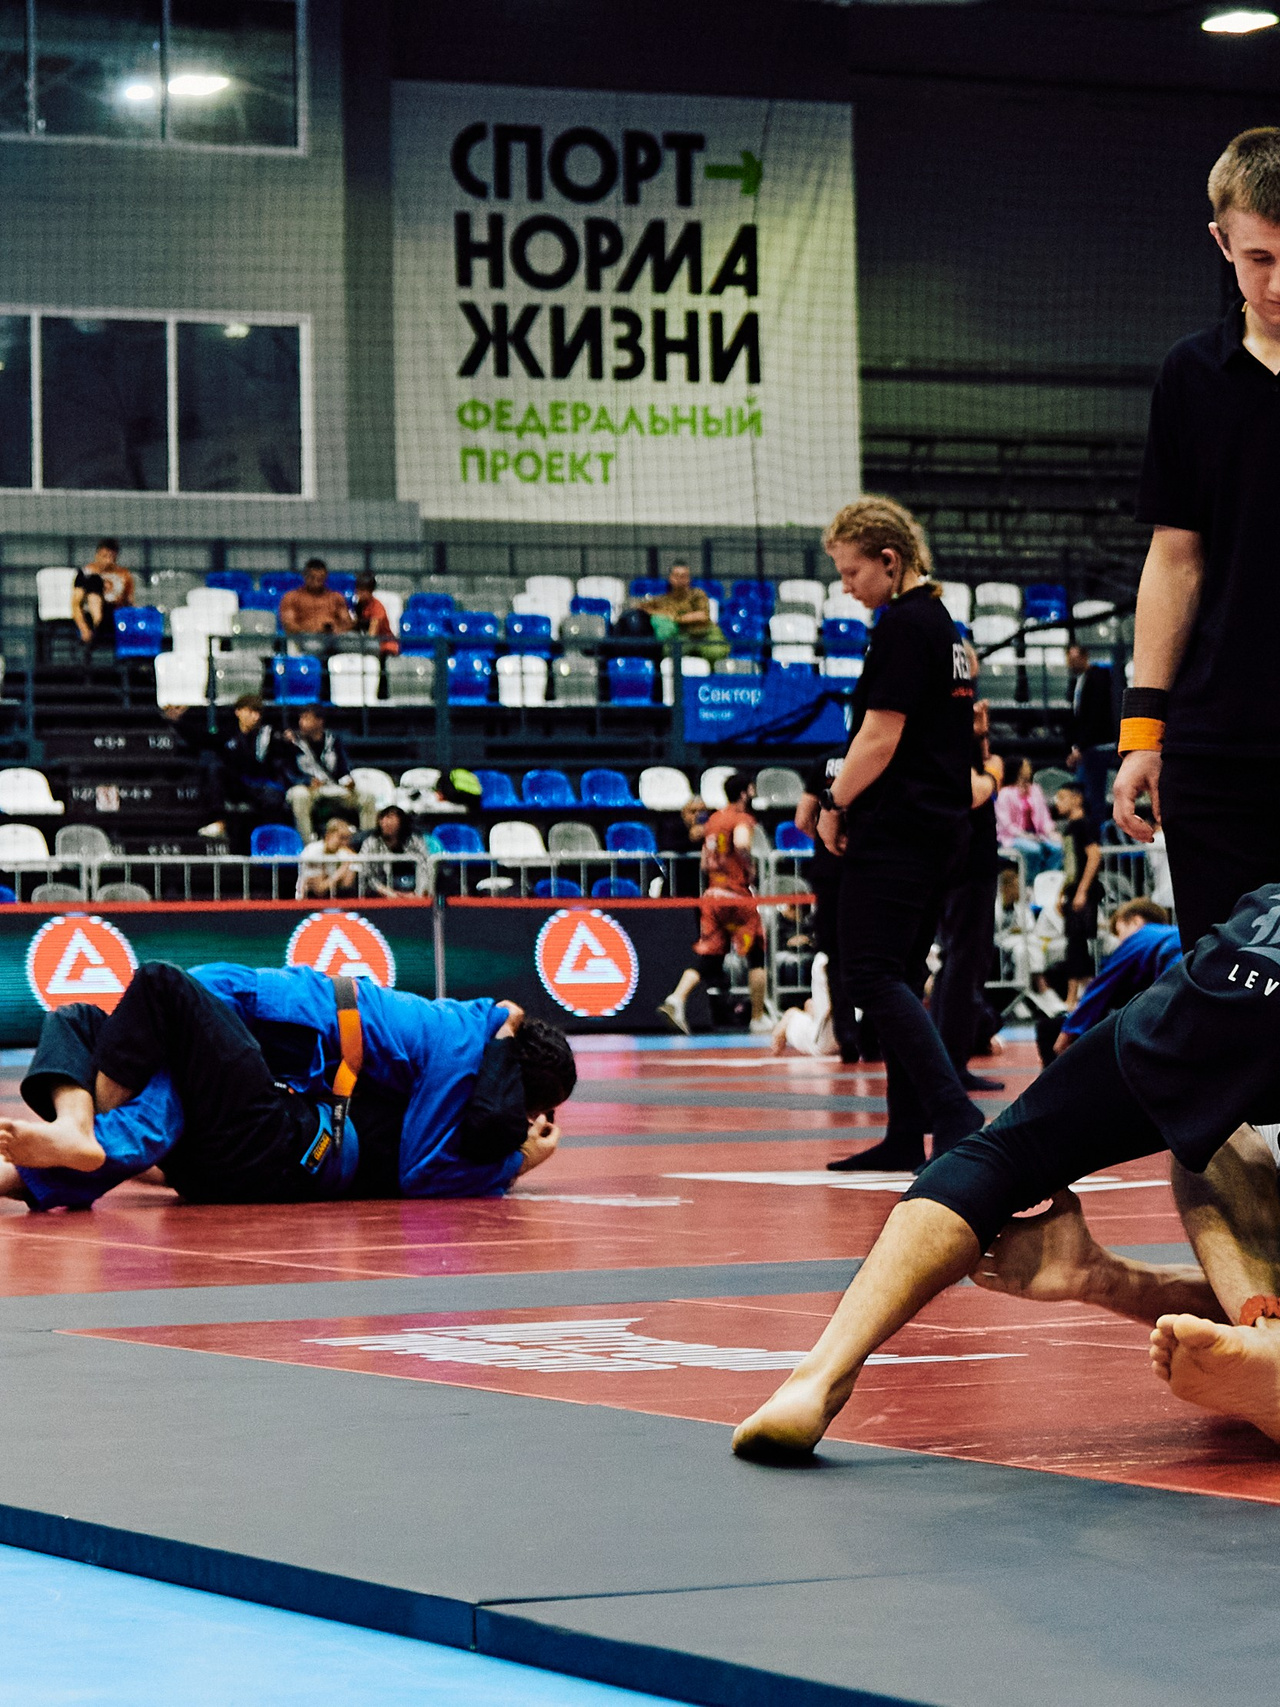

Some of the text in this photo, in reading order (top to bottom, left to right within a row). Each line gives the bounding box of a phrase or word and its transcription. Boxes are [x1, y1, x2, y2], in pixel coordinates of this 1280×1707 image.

[450, 122, 706, 207] СПОРТ
[454, 211, 759, 297] НОРМА
[456, 302, 762, 384] ЖИЗНИ
[456, 396, 763, 440] ФЕДЕРАЛЬНЫЙ
[459, 446, 616, 485] ПРОЕКТ
[698, 684, 762, 707] Сектор
